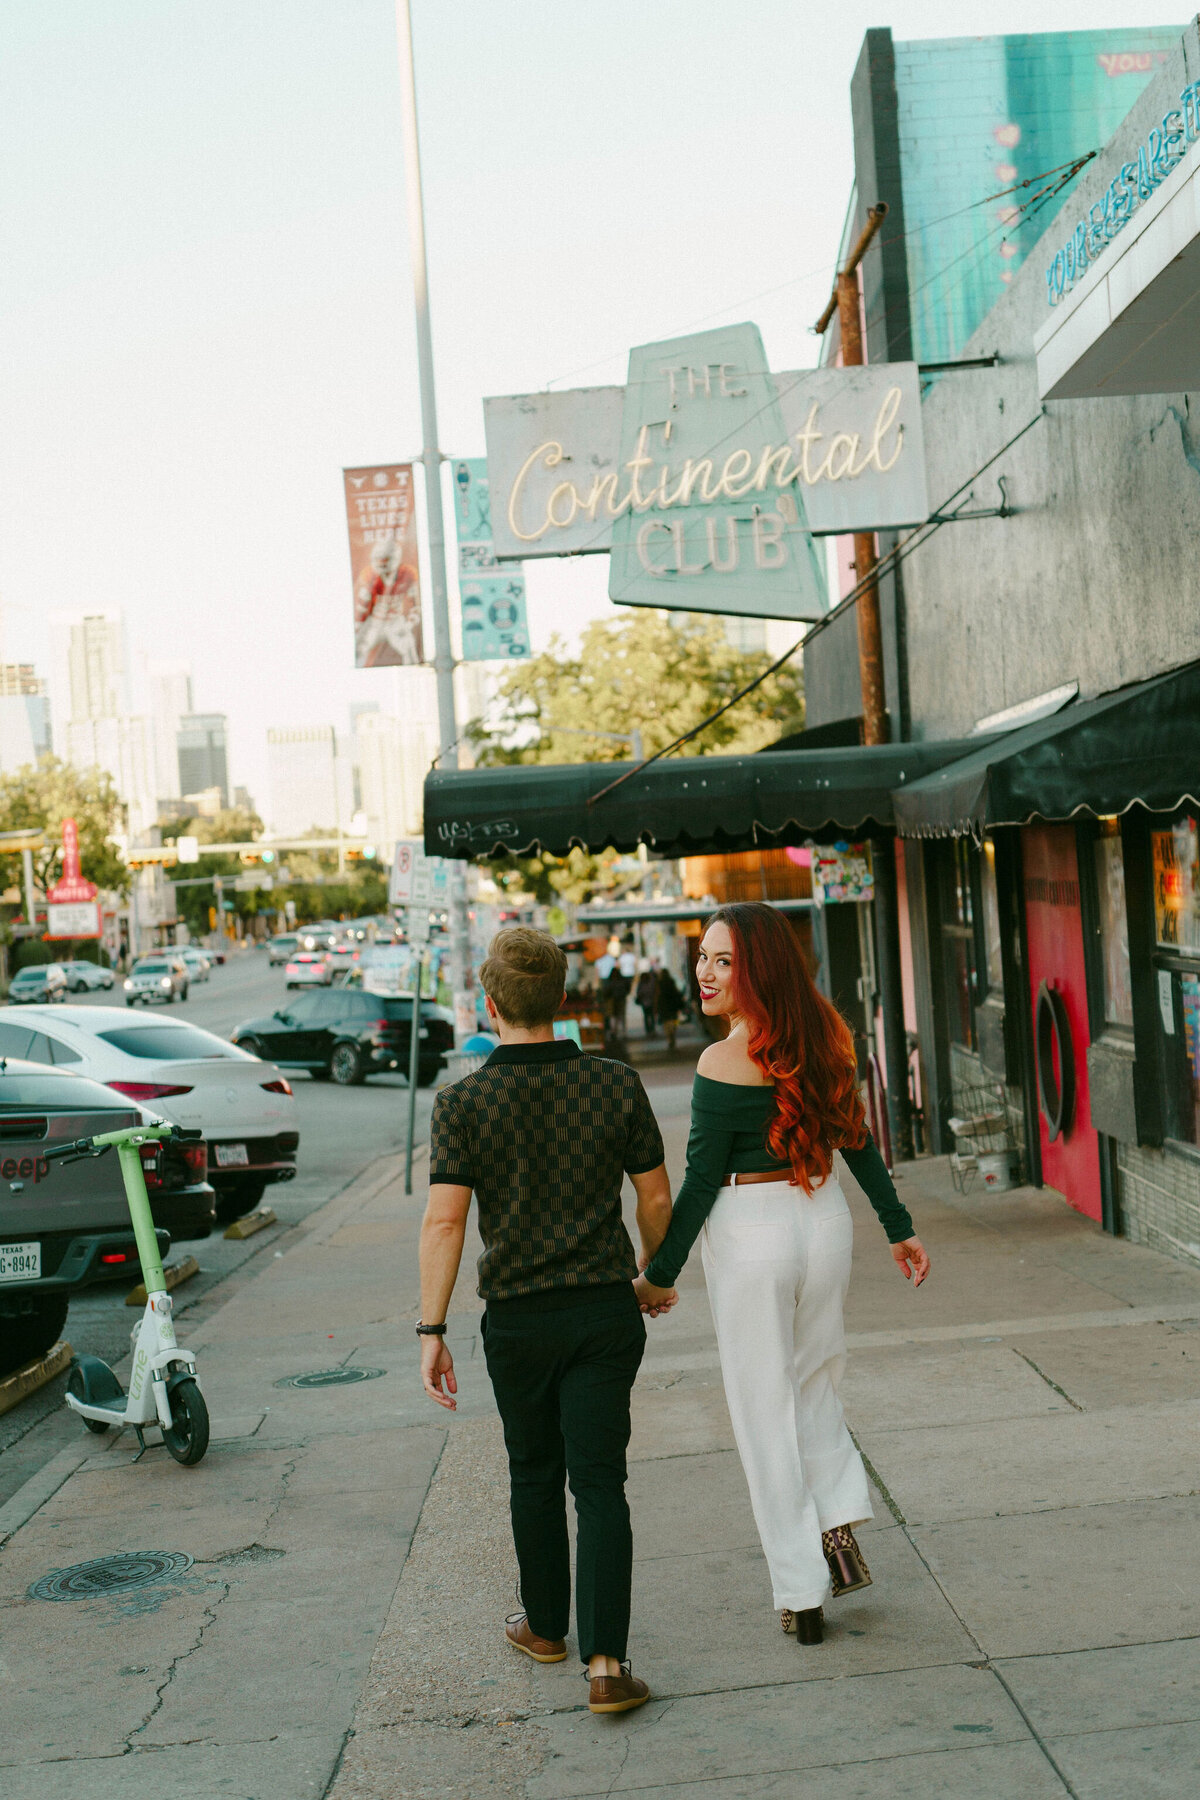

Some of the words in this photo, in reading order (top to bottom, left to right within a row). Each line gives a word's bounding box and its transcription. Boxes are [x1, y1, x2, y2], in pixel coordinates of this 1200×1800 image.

[659, 363, 747, 399] THE
[508, 387, 903, 541] Continental
[355, 495, 408, 513] TEXAS
[360, 511, 408, 529] LIVES
[636, 511, 790, 577] CLUB
[0, 1156, 50, 1183] eep
[1, 1246, 23, 1255] TEXAS
